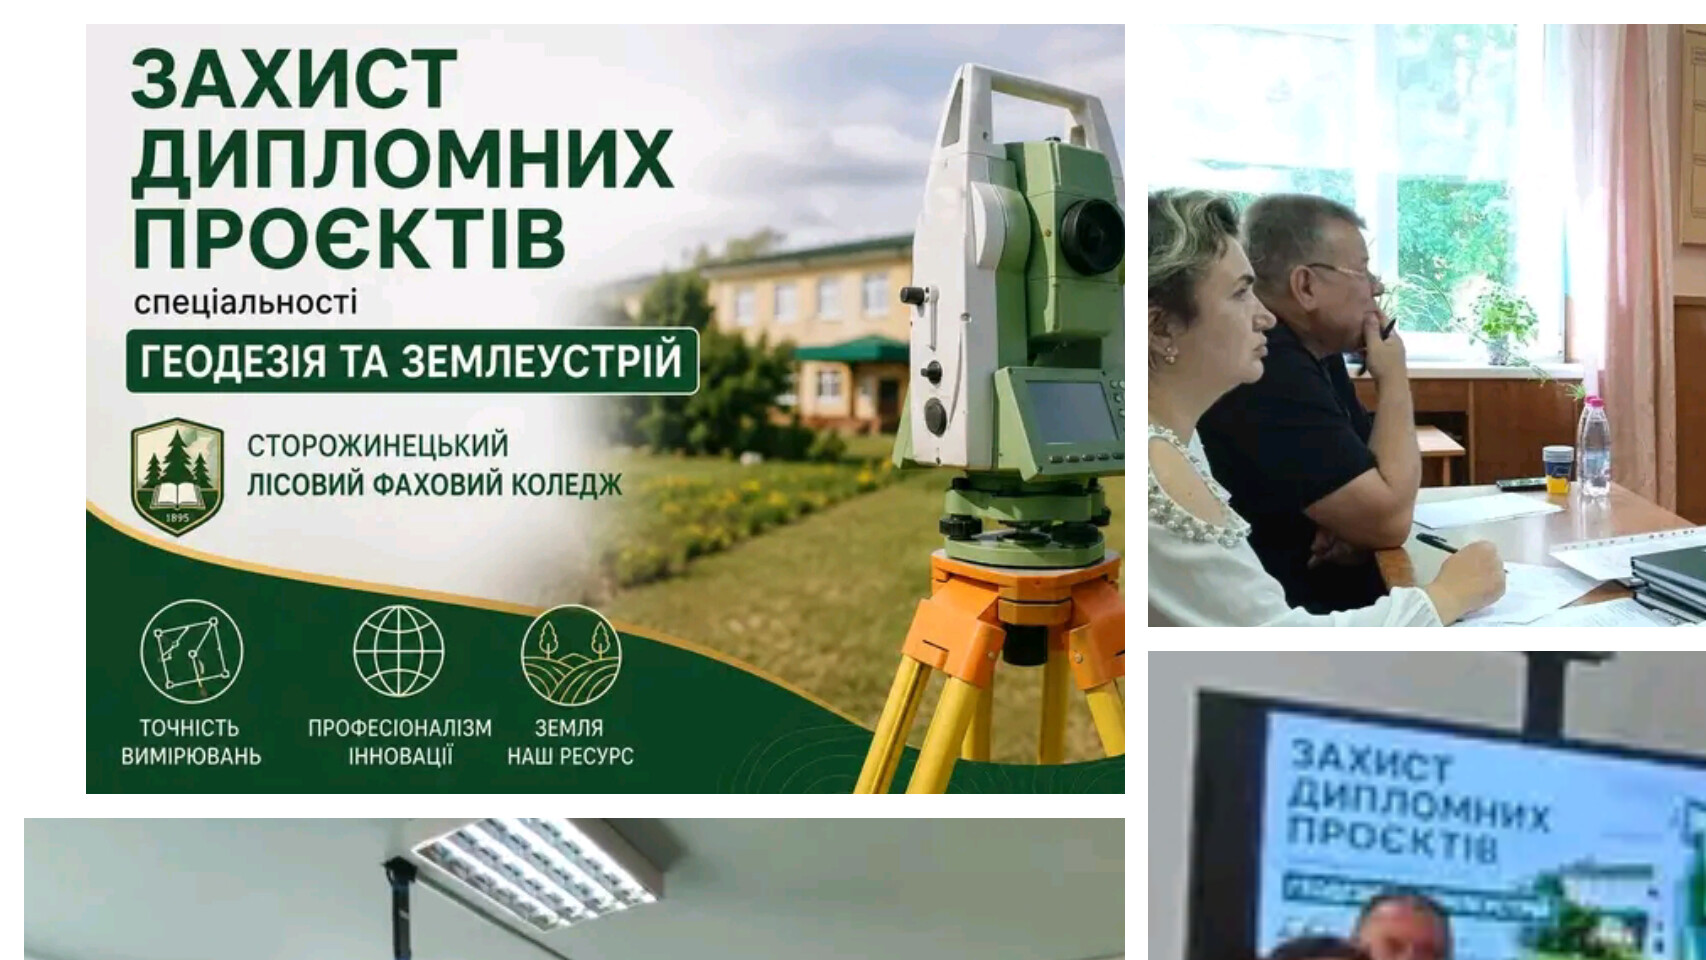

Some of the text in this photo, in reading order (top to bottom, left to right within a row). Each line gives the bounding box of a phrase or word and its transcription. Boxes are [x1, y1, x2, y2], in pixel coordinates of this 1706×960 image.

[132, 48, 457, 109] ЗАХИСТ
[132, 129, 674, 199] ДИПЛОМНИХ
[134, 208, 565, 269] ПРОЄКТІВ
[134, 287, 357, 319] спеціальності
[141, 336, 682, 384] ГЕОДЕЗІЯ ТА ЗЕМЛЕУСТРІЙ
[247, 429, 508, 461] СТОРОЖИНЕЦЬКИЙ
[247, 468, 623, 501] ЛІСОВИЙ ФАХОВИЙ КОЛЕДЖ
[165, 513, 190, 523] 1895
[139, 718, 239, 738] ТОЧНІСТЬ
[308, 718, 492, 738] ПРОФЕСІОНАЛІЗМ
[535, 718, 603, 738] ЗЕМЛЯ
[121, 746, 262, 766] ВИМІРЮВАНЬ
[348, 746, 454, 768] ІННОВАЦІЇ
[508, 746, 635, 766] НАШ РЕСУРС
[1291, 738, 1455, 785] ЗАХИСТ
[1287, 776, 1550, 834] ДИПЛОМНИХ
[1287, 815, 1498, 864] ПРОЄКТІВ
